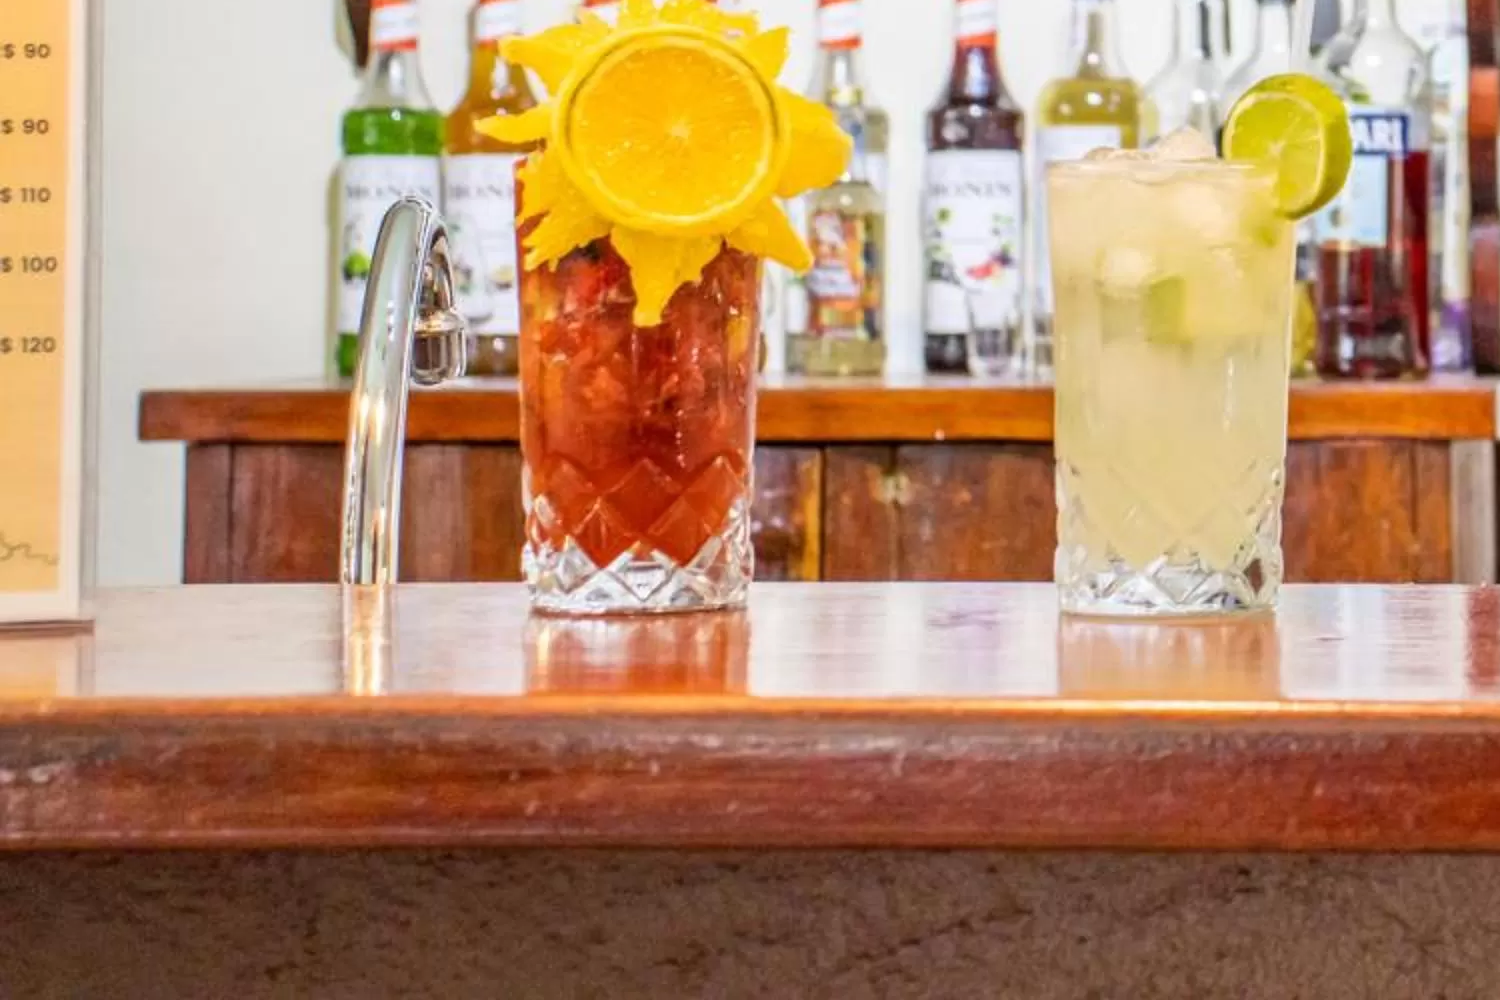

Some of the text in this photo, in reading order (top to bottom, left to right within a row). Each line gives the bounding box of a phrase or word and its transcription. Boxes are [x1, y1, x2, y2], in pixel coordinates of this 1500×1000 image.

[24, 43, 52, 59] 90
[22, 119, 50, 134] 90
[20, 187, 52, 203] 110
[21, 256, 57, 273] 100
[21, 336, 57, 353] 120
